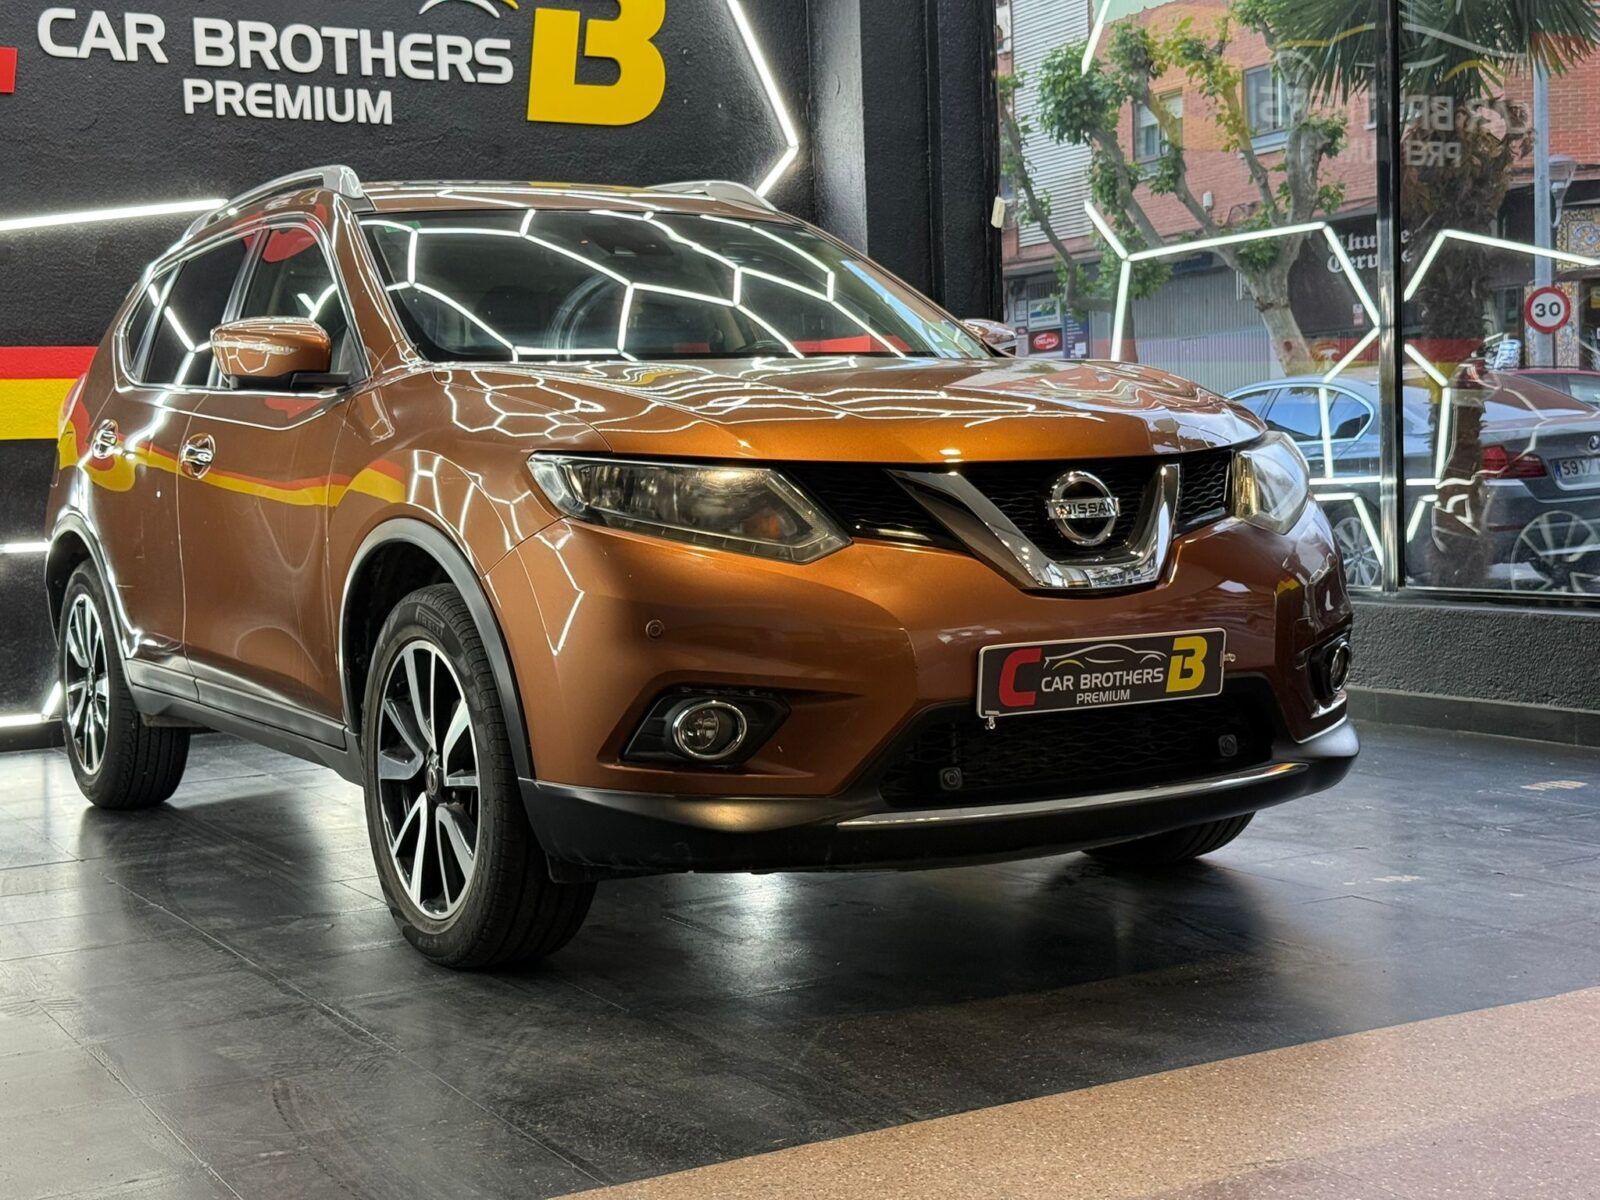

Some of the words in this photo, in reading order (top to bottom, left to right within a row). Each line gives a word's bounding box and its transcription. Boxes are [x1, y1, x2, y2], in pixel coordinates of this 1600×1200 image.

[37, 8, 169, 63] CAR
[193, 17, 514, 84] BROTHERS
[183, 78, 393, 125] PREMIUM
[1535, 302, 1561, 318] 30
[1059, 500, 1116, 515] NISSAN
[1041, 676, 1074, 692] CAR
[1080, 667, 1164, 690] BROTHERS
[1076, 689, 1131, 704] PREMIUM
